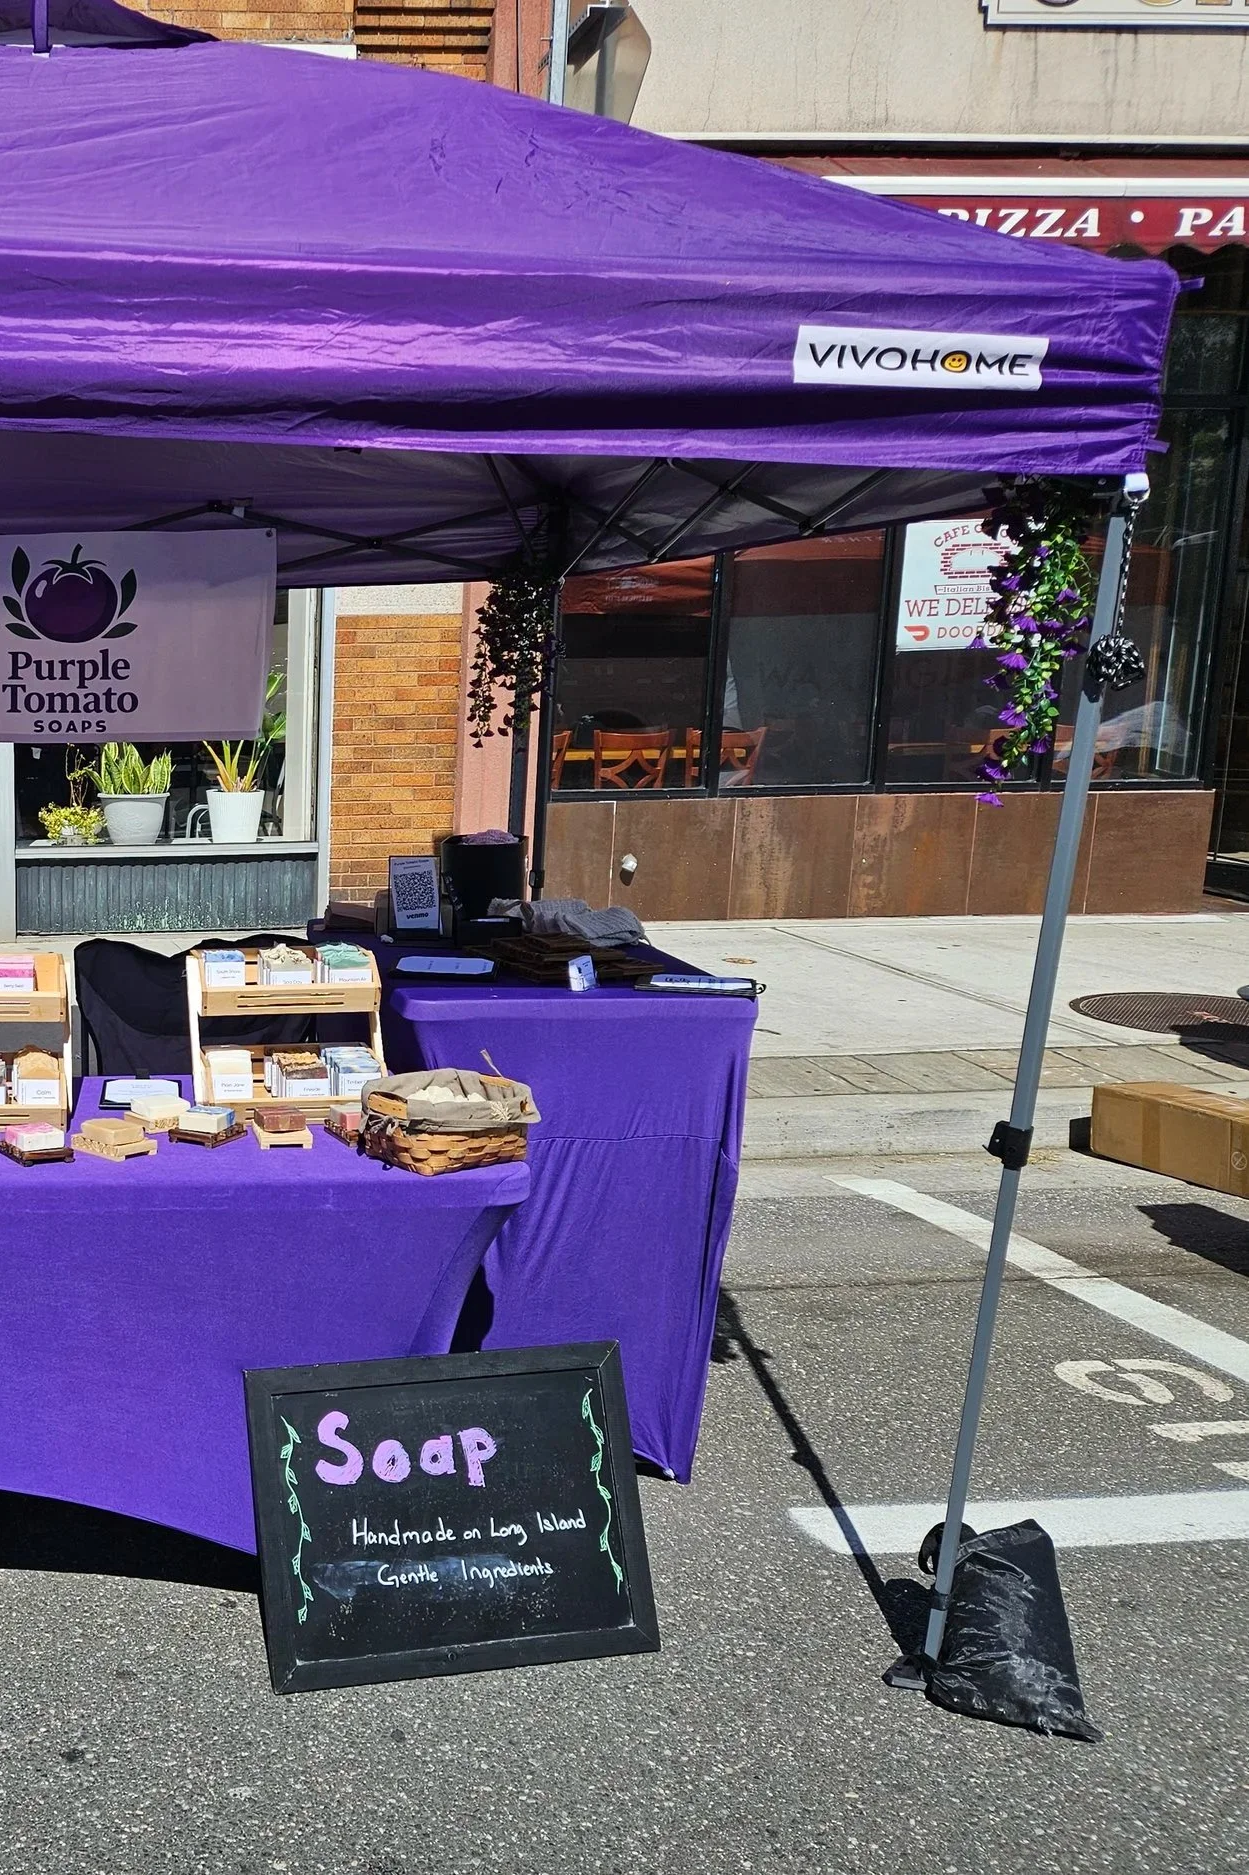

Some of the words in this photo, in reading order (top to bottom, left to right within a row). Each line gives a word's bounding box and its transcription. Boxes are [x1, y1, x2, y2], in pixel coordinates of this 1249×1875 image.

[1174, 206, 1247, 237] PA
[808, 342, 1034, 377] VIVOHOME
[933, 524, 971, 548] CAFE
[904, 598, 940, 618] WE
[6, 648, 132, 690] Purple
[2, 682, 139, 715] Tomato
[32, 719, 108, 734] SOAPS
[406, 911, 429, 920] venmo
[315, 1410, 498, 1488] Soap
[351, 1516, 456, 1547] Handmade
[462, 1527, 482, 1541] on
[490, 1514, 528, 1546] Long
[537, 1507, 588, 1534] Island
[376, 1562, 440, 1589] Gentle
[460, 1560, 555, 1589] Ingredients
